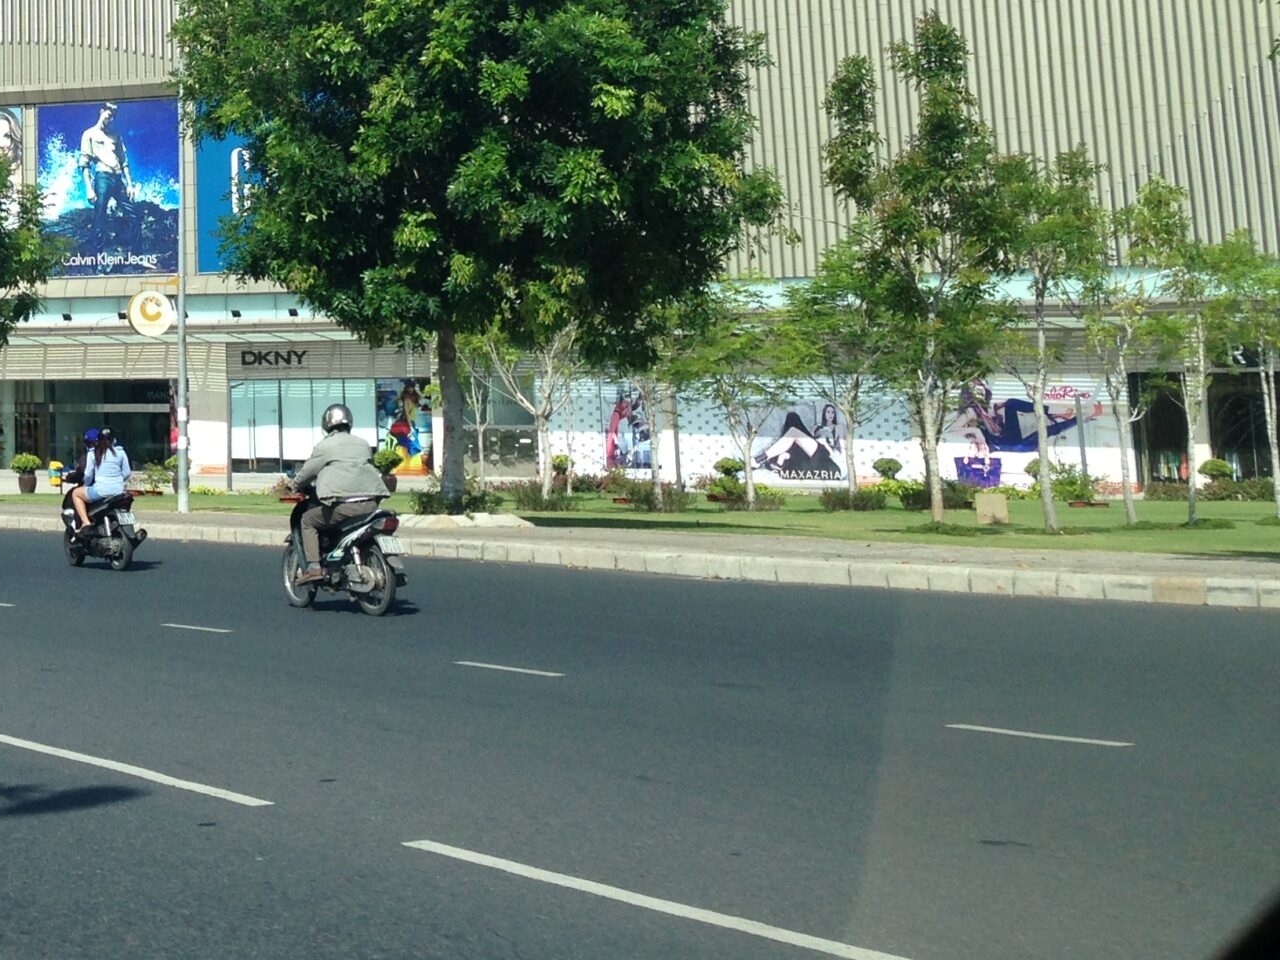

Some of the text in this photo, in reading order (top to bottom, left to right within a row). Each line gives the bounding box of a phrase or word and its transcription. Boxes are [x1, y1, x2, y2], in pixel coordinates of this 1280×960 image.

[61, 251, 157, 266] Calvin Klein Jeans
[241, 350, 307, 366] DKNY
